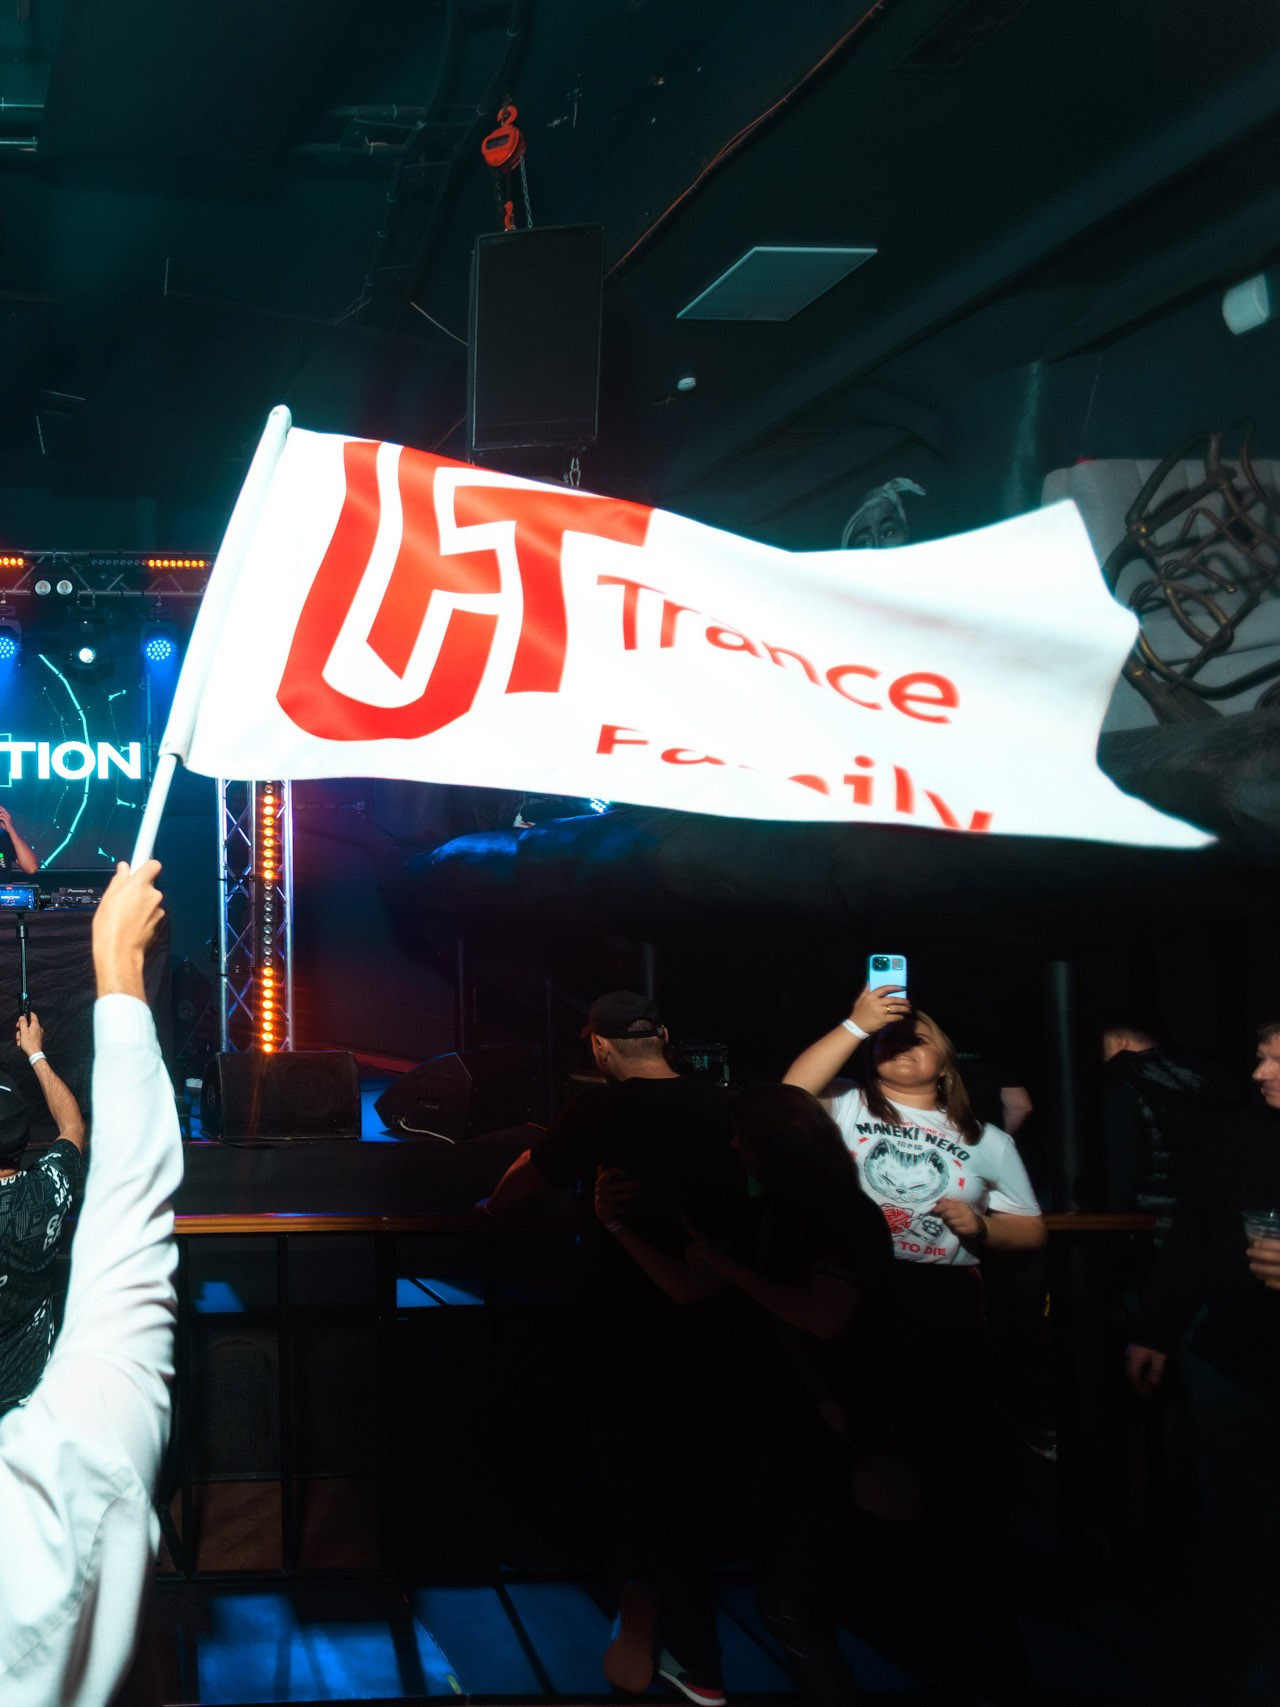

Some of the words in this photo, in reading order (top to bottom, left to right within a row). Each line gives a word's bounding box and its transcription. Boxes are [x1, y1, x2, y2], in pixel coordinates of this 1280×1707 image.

[596, 574, 959, 724] Trance
[596, 724, 993, 832] Faily
[856, 1122, 920, 1141] MANEKI
[925, 1133, 971, 1162] NEKO
[900, 1241, 921, 1253] TO
[924, 1246, 947, 1256] DIE
